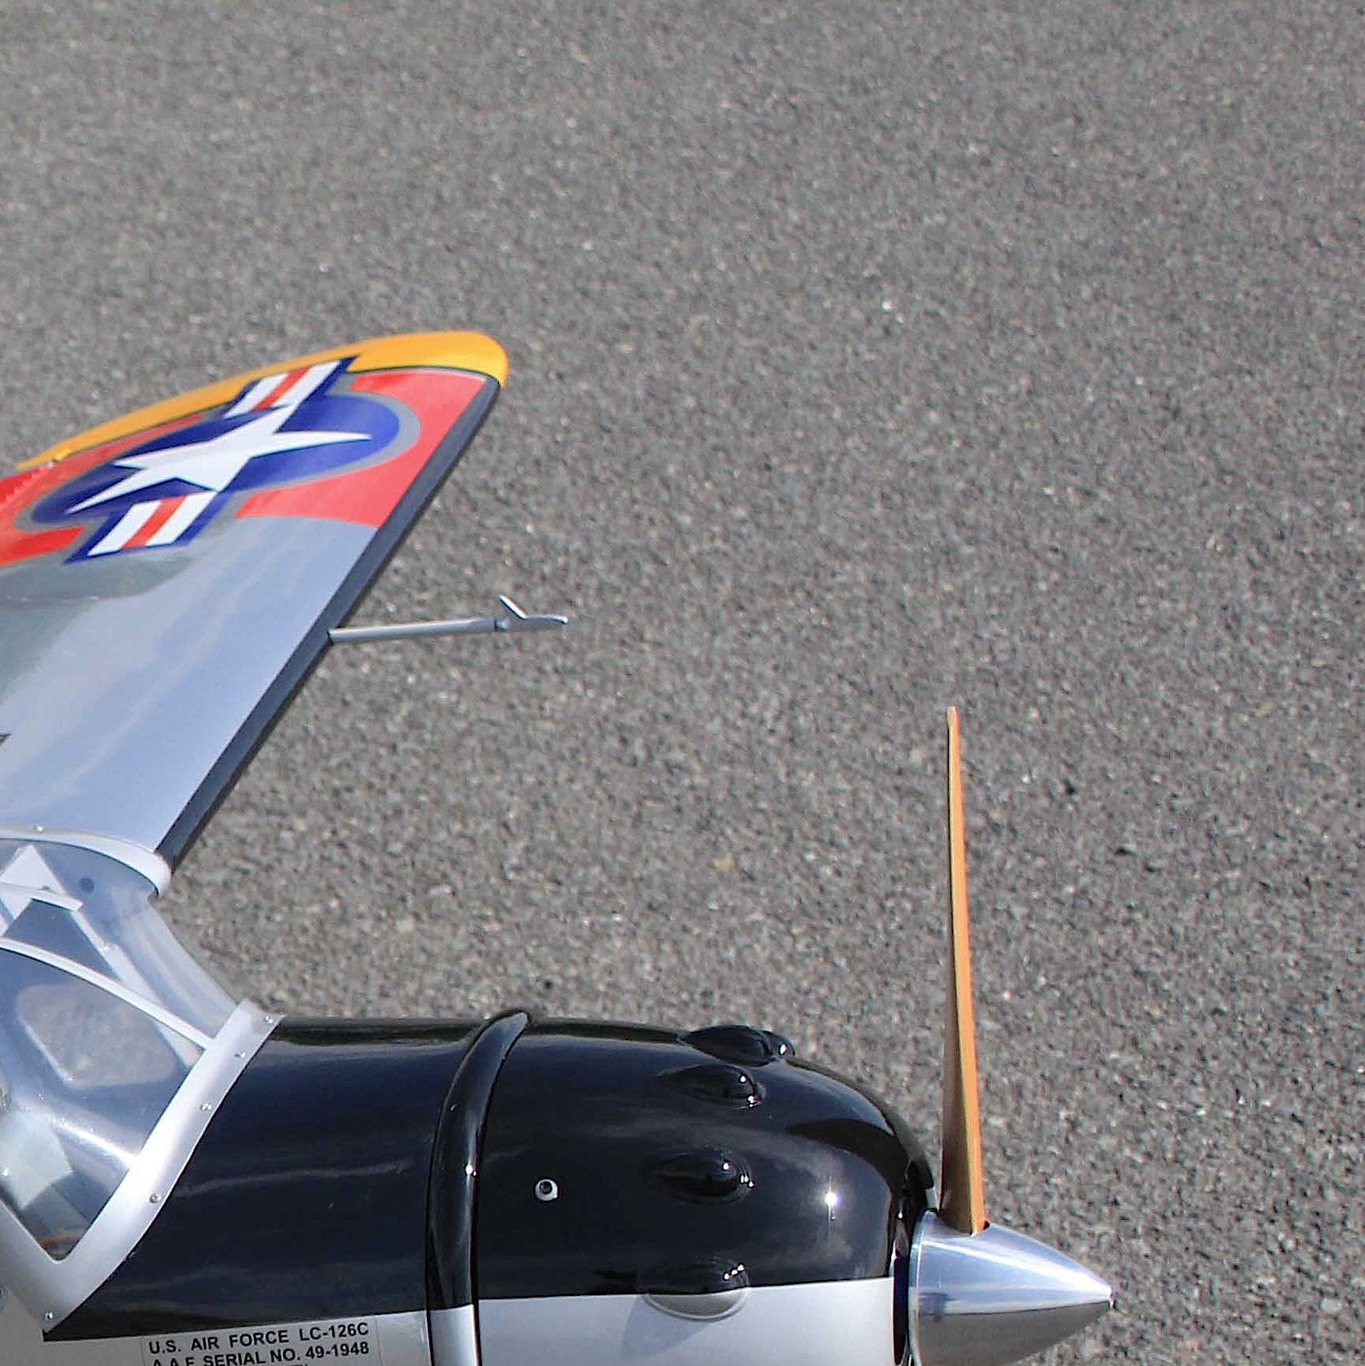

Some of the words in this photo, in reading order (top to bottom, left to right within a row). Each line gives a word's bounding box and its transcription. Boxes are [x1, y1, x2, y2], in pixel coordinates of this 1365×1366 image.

[148, 1339, 182, 1355] U.S.
[190, 1336, 220, 1351] AIR
[229, 1329, 290, 1349] FORCE
[299, 1321, 369, 1342] LC-126C
[270, 1347, 301, 1364] NO.
[305, 1341, 370, 1360] 49-1948
